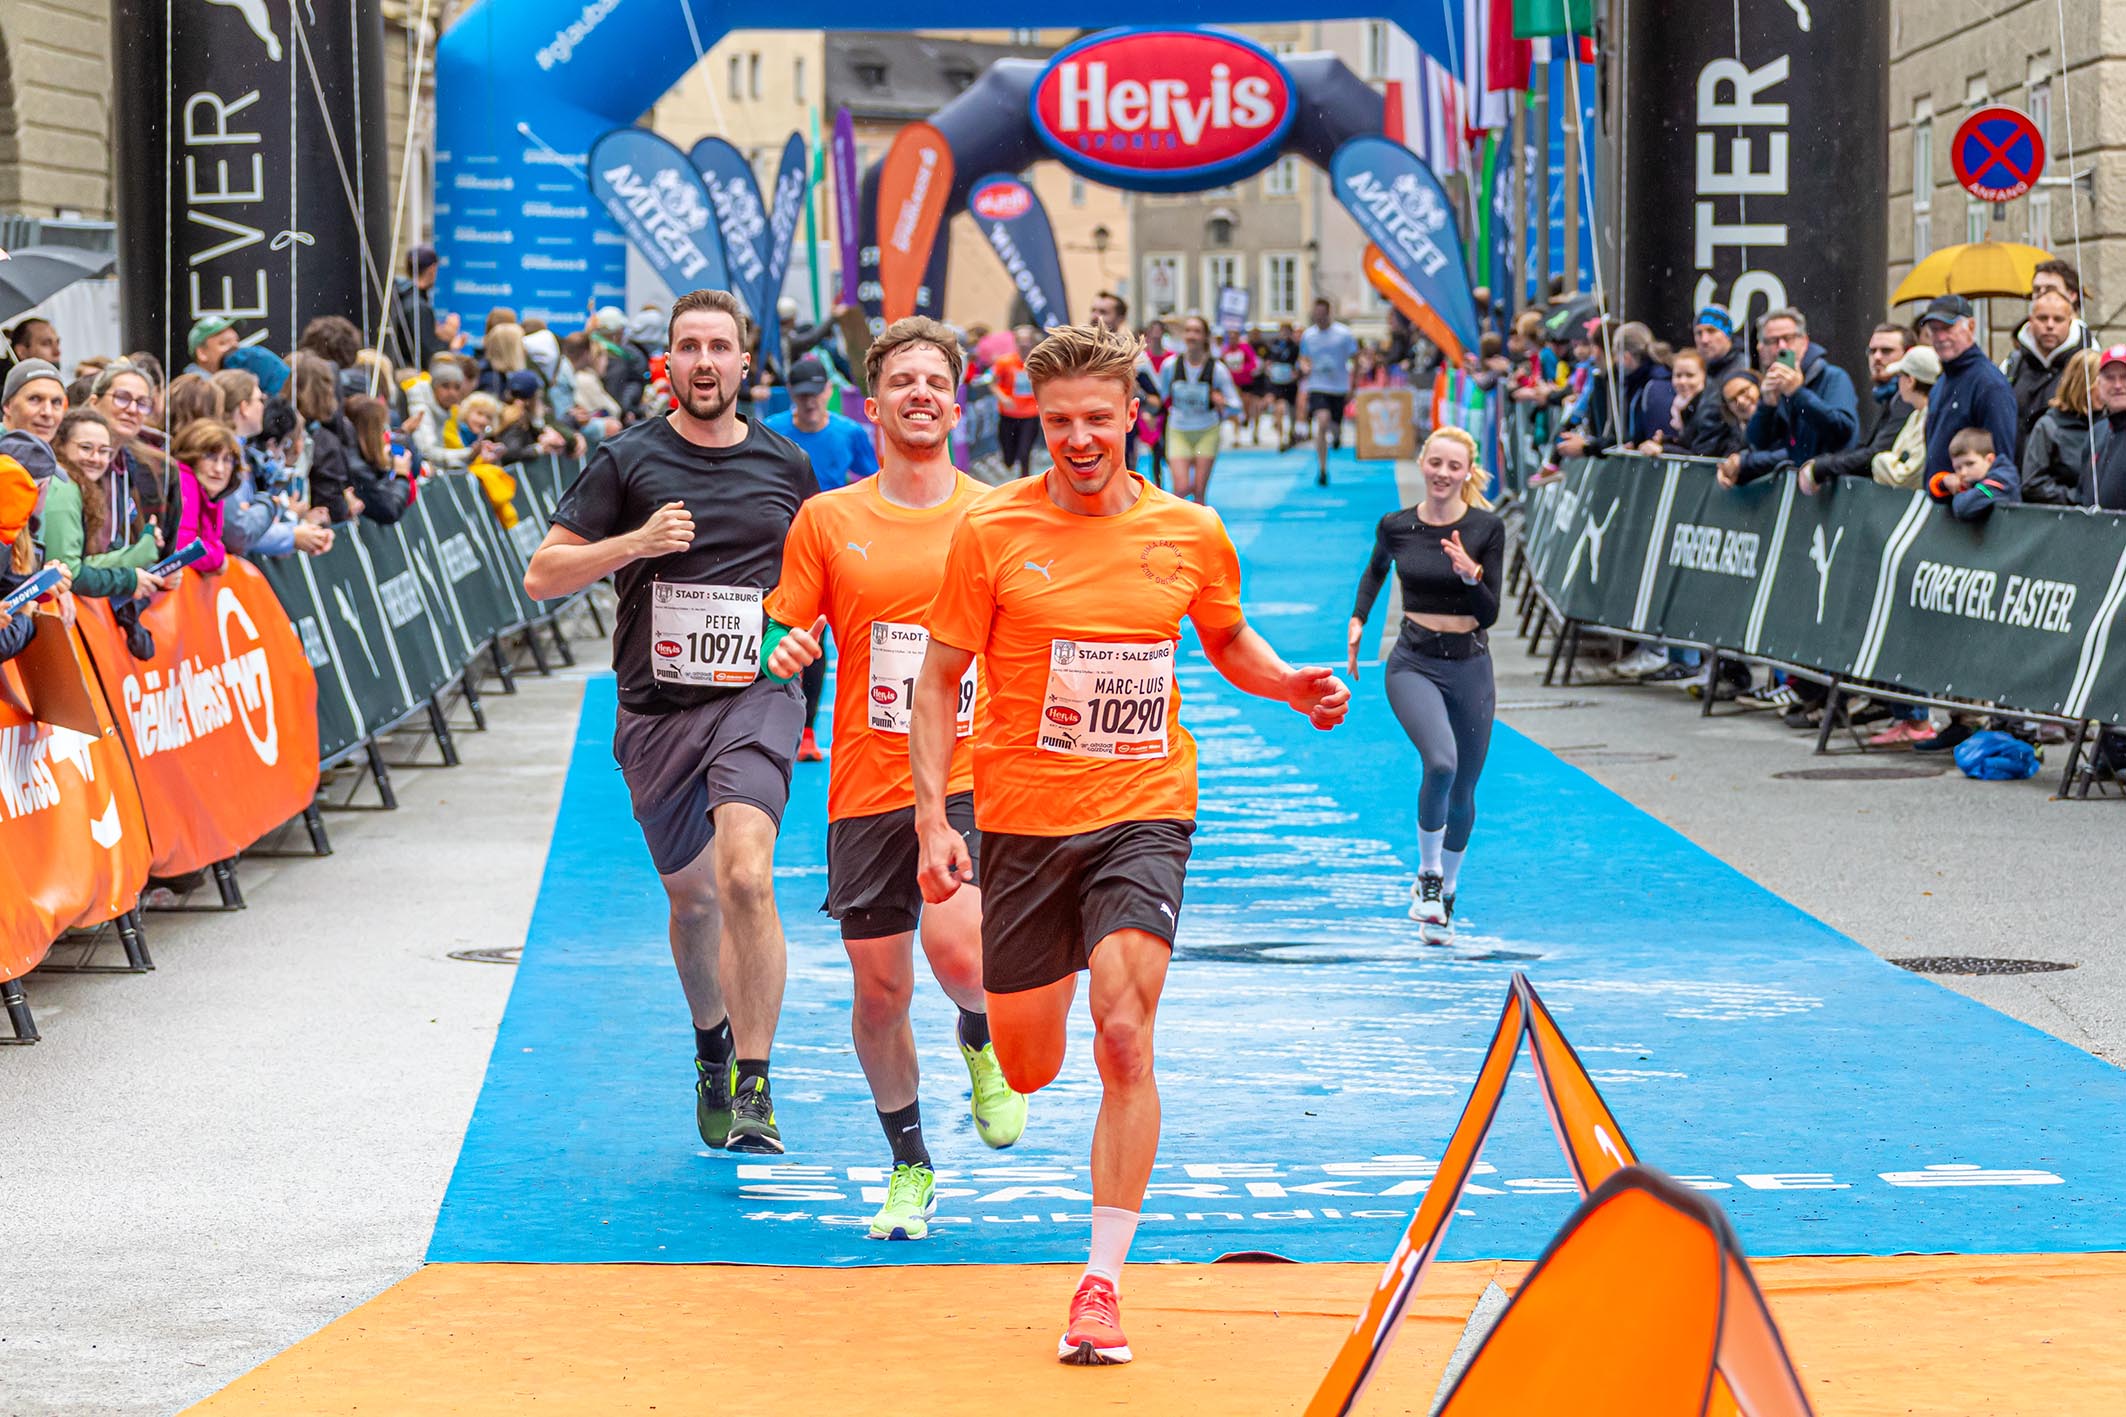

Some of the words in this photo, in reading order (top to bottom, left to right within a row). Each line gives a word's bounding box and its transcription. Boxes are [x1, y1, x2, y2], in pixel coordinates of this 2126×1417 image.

[1058, 61, 1275, 145] Hervis
[1967, 181, 2029, 201] ANFANG
[184, 90, 269, 347] EVER
[675, 590, 705, 600] STADT
[712, 592, 758, 603] SALZBURG
[1910, 560, 1998, 623] FOREVER.
[2000, 574, 2078, 634] FASTER.
[705, 615, 740, 630] PETER
[891, 631, 923, 642] STADT
[656, 643, 681, 655] Hervis
[686, 632, 757, 665] 10974
[1079, 650, 1114, 660] STADT
[1122, 648, 1169, 661] SALZBURG
[656, 669, 678, 679] PUMA
[1095, 676, 1164, 695] MARC-LUIS
[873, 688, 895, 701] Hervis
[1049, 708, 1078, 722] Hervis
[1087, 696, 1165, 735] 10290
[872, 716, 892, 729] PUMA
[1042, 736, 1072, 750] PUMA
[737, 1164, 1289, 1183] ERSE
